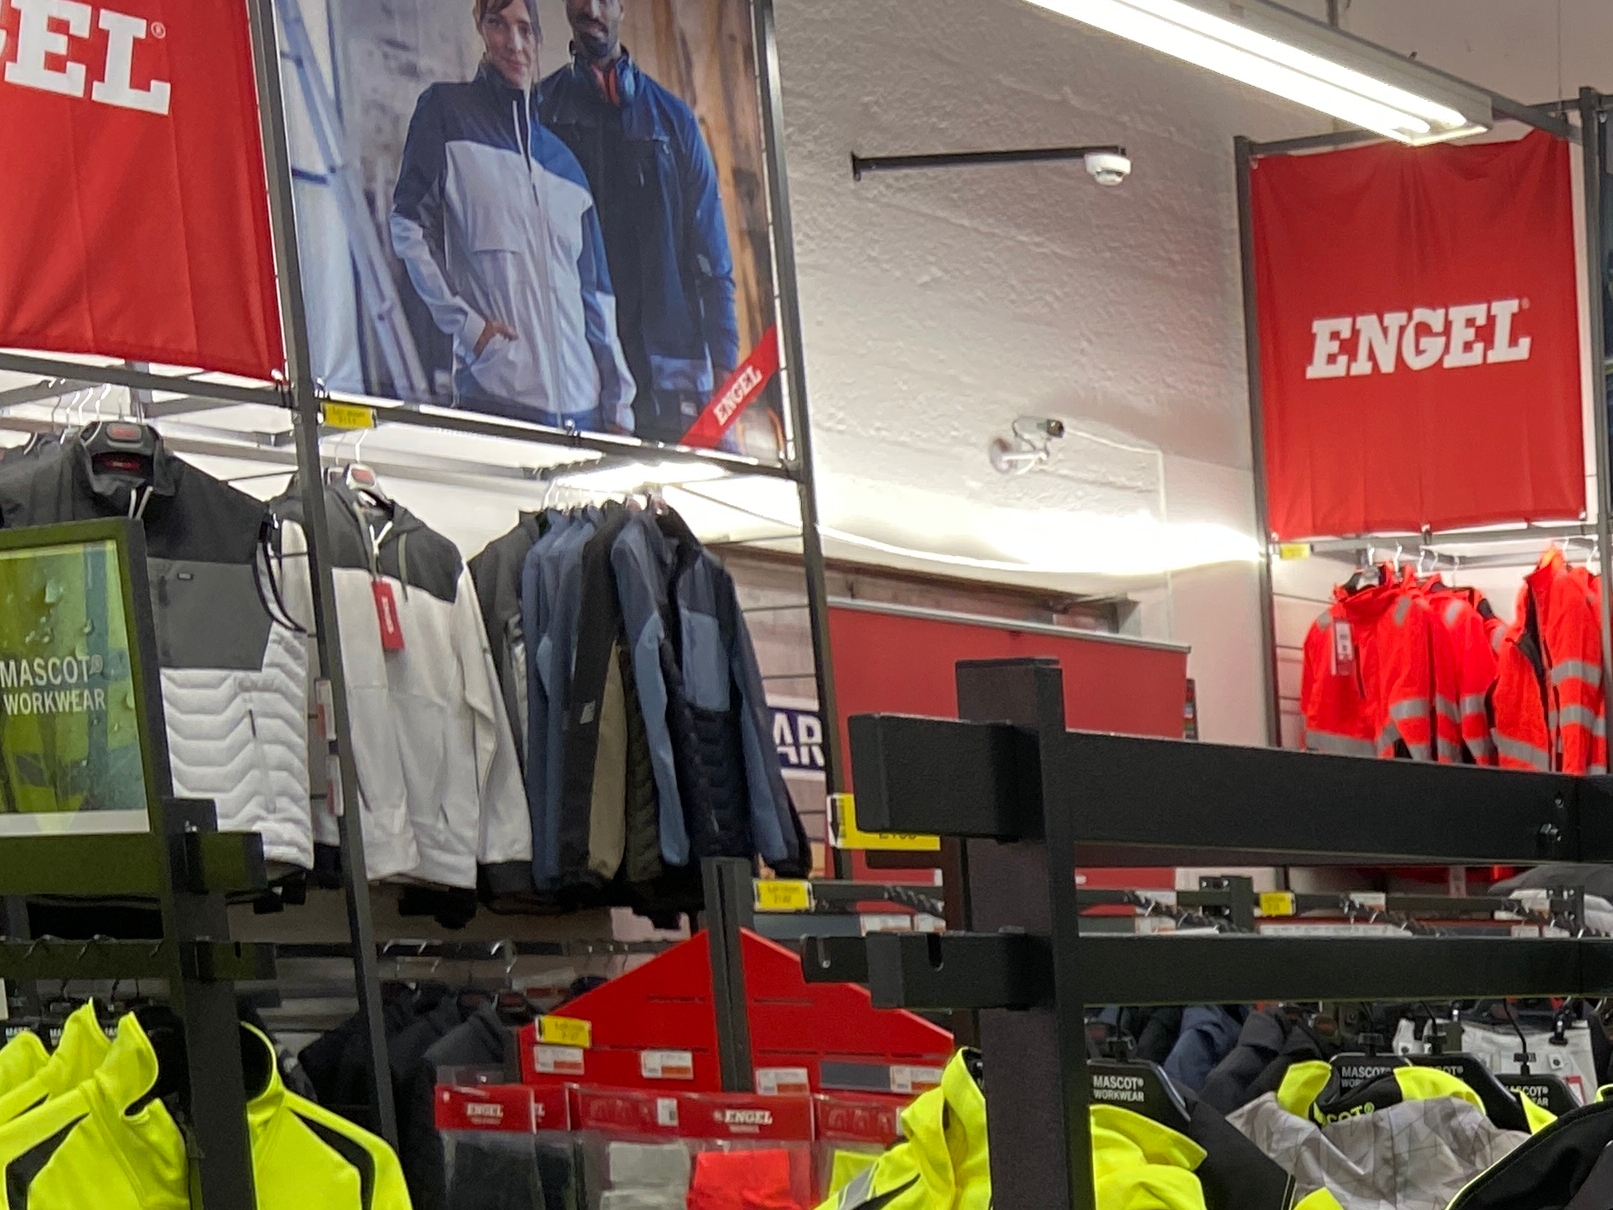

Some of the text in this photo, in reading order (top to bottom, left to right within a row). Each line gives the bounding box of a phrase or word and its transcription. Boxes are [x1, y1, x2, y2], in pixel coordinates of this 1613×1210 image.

[713, 365, 763, 427] ENGEL
[3, 687, 106, 716] WORKWEAR
[1093, 1088, 1145, 1102] WORKWEAR
